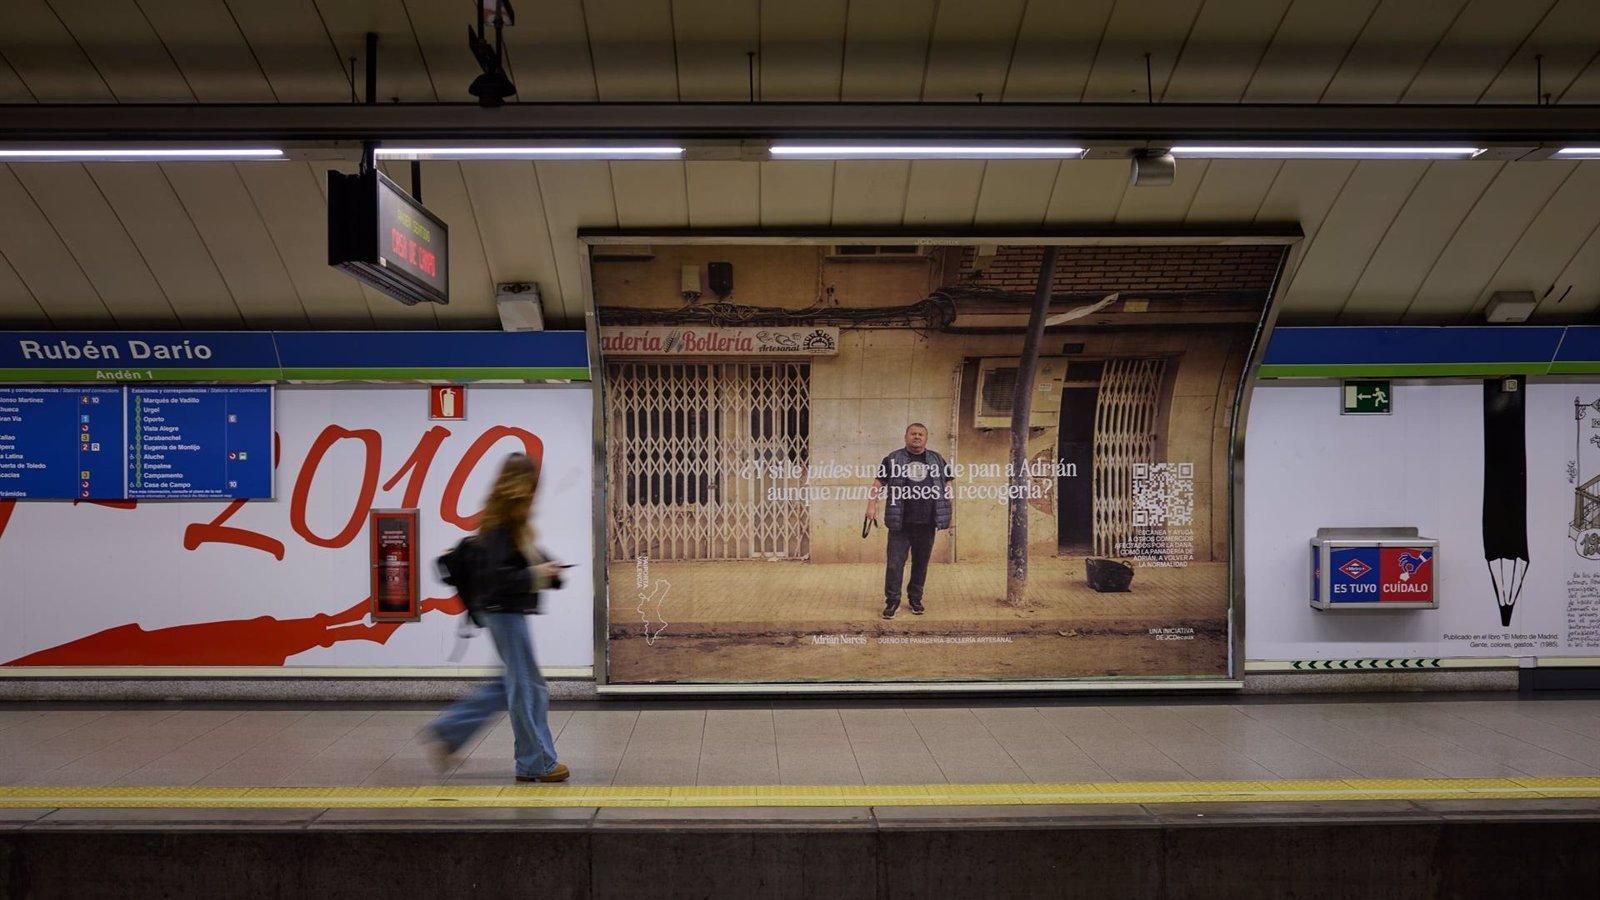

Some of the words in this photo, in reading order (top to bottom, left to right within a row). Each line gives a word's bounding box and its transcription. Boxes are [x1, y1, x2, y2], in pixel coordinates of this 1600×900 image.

[682, 331, 753, 351] Bollería
[20, 340, 119, 360] Rubén
[128, 340, 212, 360] Darío
[758, 344, 800, 352] Artesanal
[96, 370, 141, 380] Andén
[146, 371, 153, 379] 1
[769, 460, 784, 479] si
[786, 460, 802, 479] le
[804, 459, 851, 483] pides
[855, 463, 887, 479] una
[890, 459, 940, 479] barra
[944, 458, 964, 478] de
[968, 461, 1000, 482] pan
[1005, 462, 1016, 477] a
[1019, 458, 1077, 478] Adrián
[768, 485, 831, 507] aunque
[834, 484, 888, 501] nunca
[890, 484, 940, 506] pases
[944, 485, 954, 499] a
[958, 479, 1053, 505] recogerla?
[1334, 584, 1347, 592] ES
[1351, 584, 1377, 592] TUYO
[1383, 581, 1428, 592] CUÍDALO
[811, 634, 839, 645] Adrián
